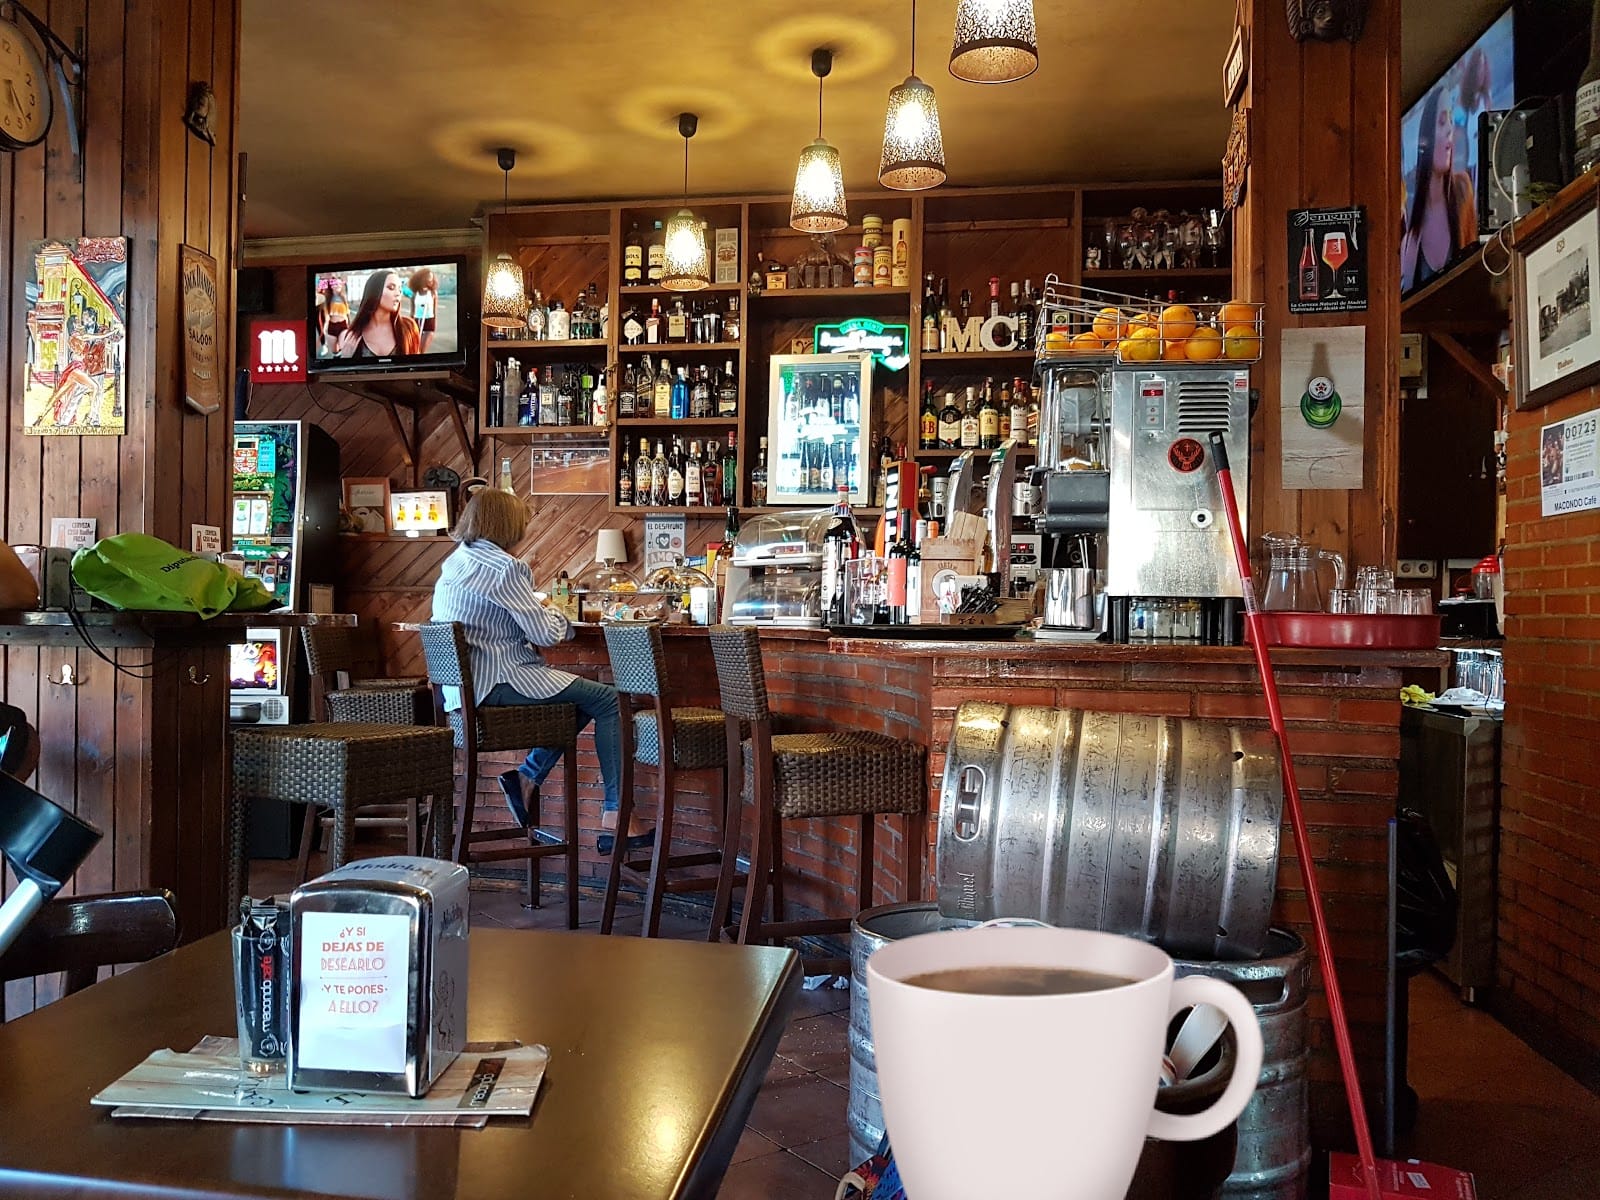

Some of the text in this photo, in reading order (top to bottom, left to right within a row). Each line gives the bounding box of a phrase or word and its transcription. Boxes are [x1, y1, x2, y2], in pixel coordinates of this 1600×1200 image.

[25, 73, 32, 87] 2
[29, 93, 35, 106] 3
[188, 328, 213, 346] SALOON
[1565, 419, 1597, 440] 00723
[1554, 498, 1584, 511] MACONDO
[356, 927, 366, 937] SI
[322, 941, 385, 952] DEJAS DE
[320, 957, 386, 971] DESEARLO
[334, 985, 346, 994] TE
[347, 984, 384, 994] PONES
[328, 1000, 379, 1014] A ELLO?
